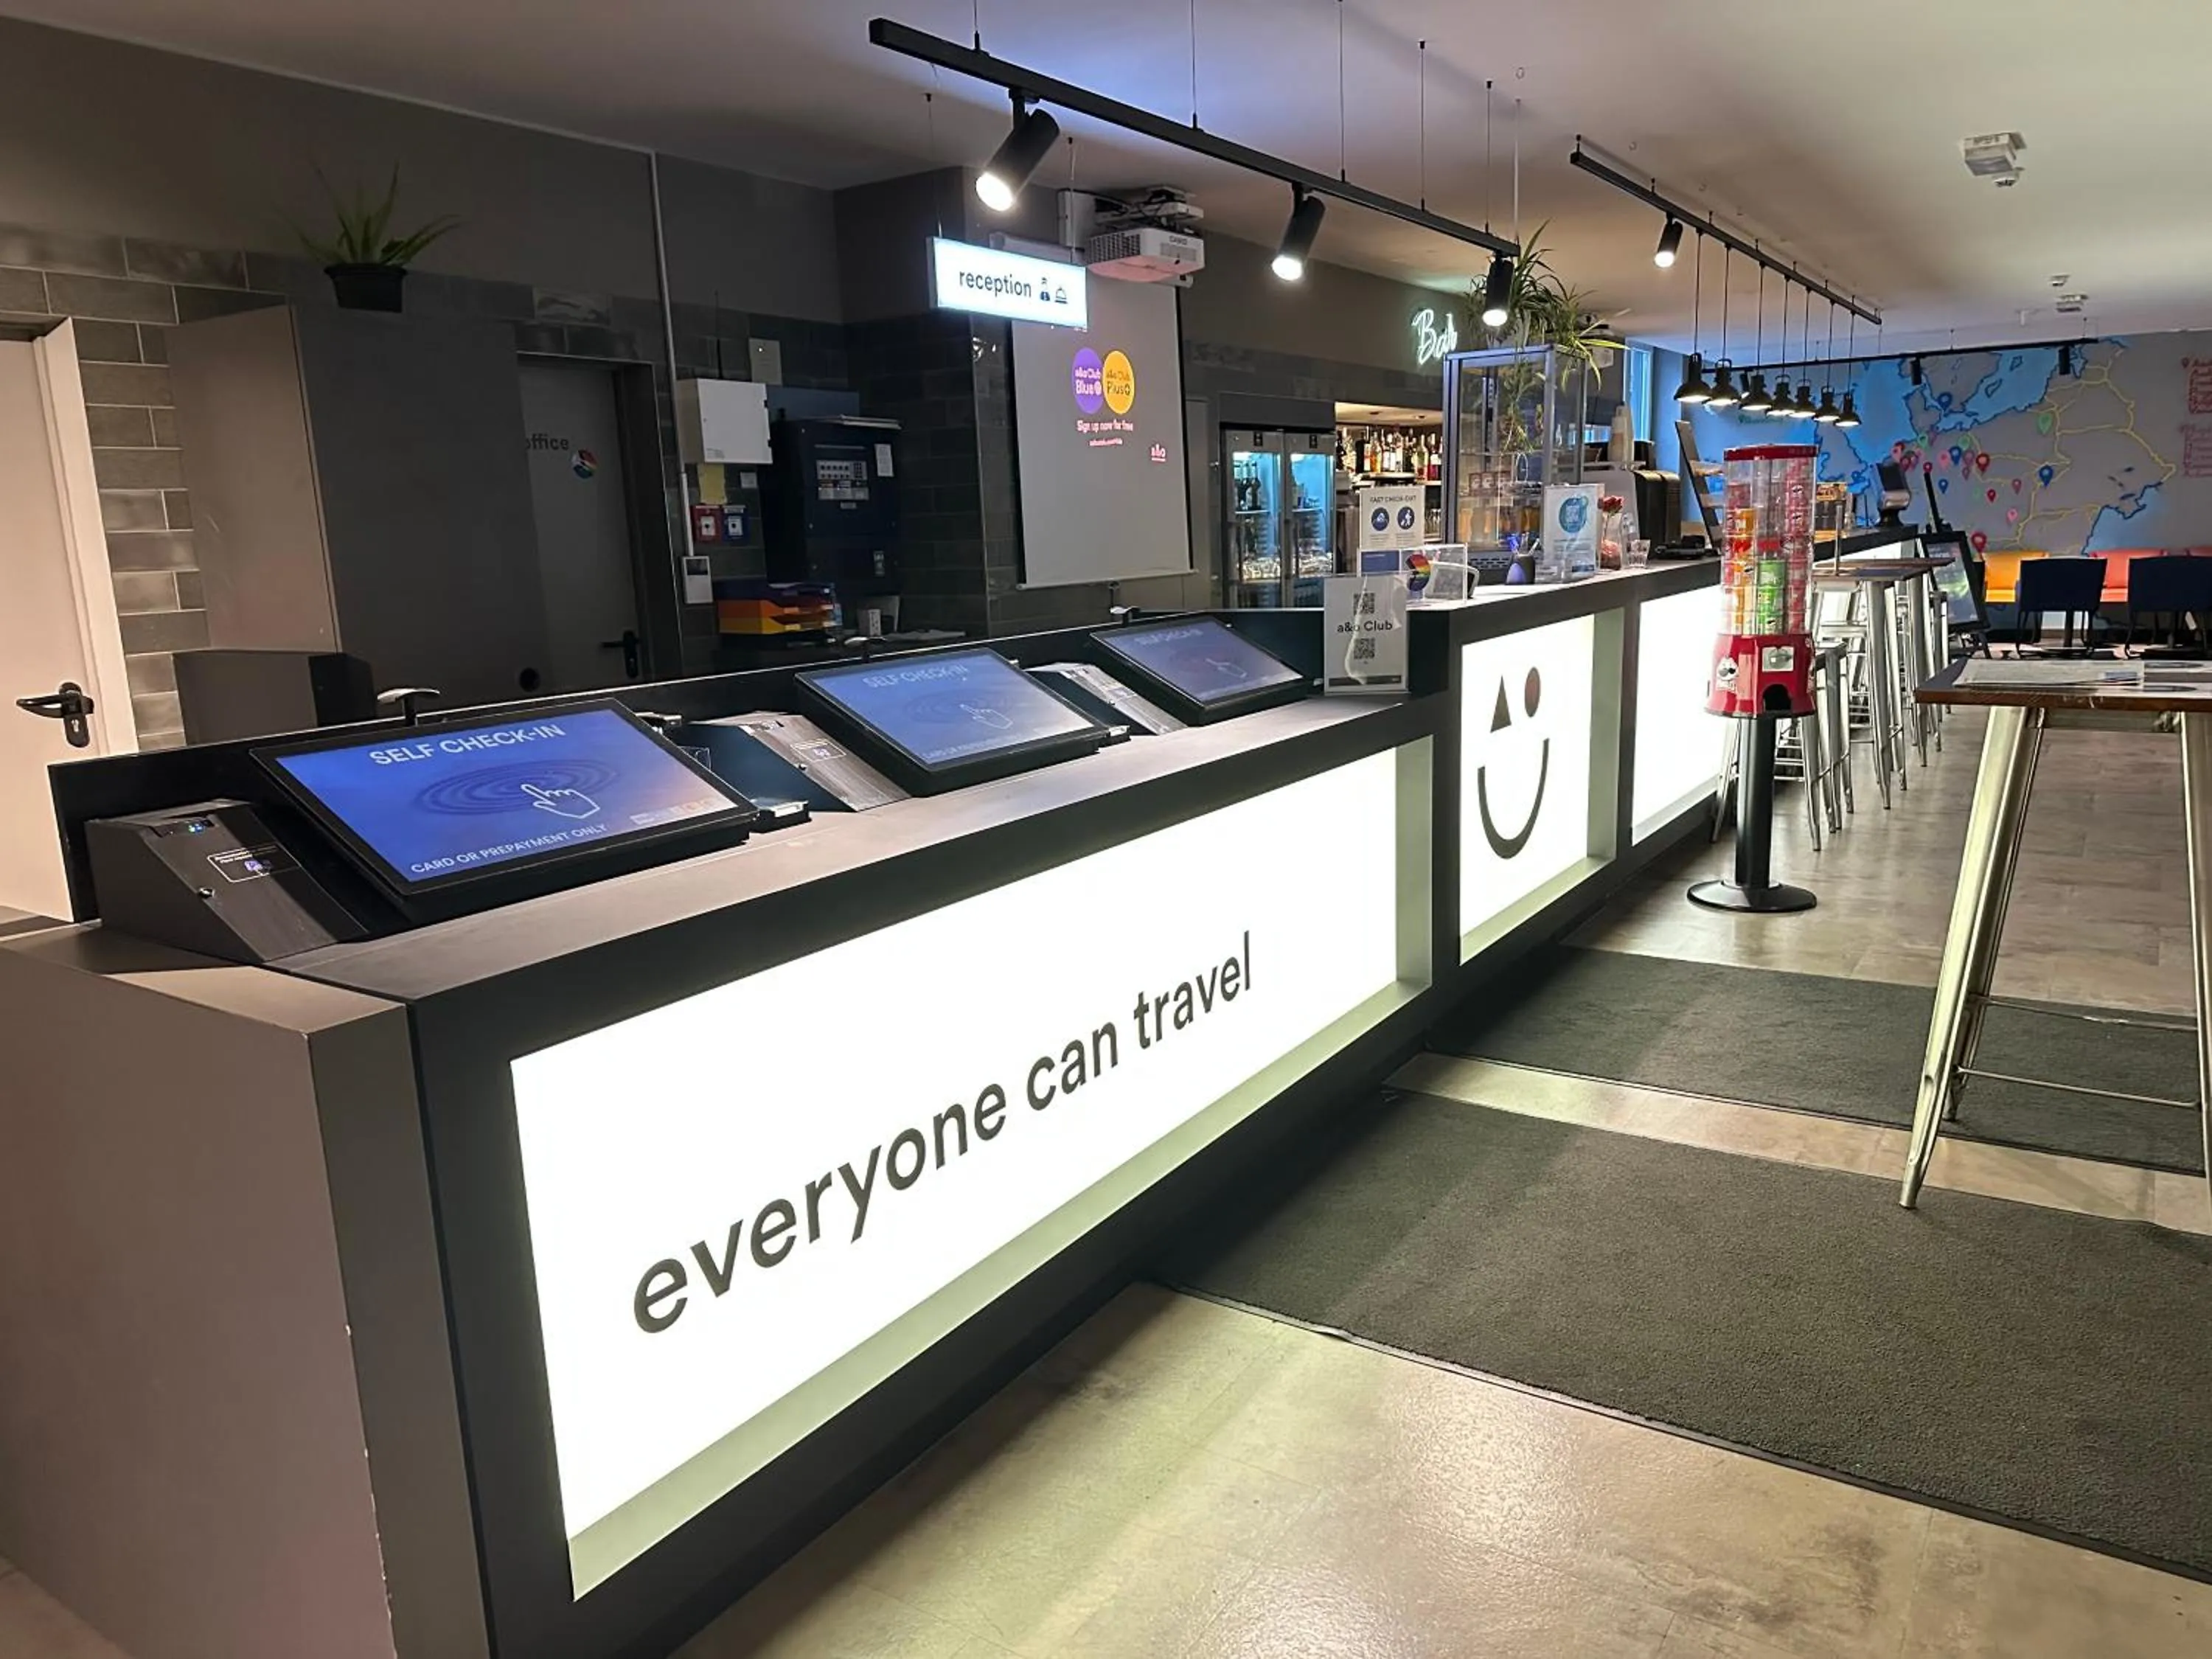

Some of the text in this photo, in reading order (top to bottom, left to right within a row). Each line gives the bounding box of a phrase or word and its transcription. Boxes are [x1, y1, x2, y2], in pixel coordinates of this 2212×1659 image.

[959, 271, 1032, 297] reception
[1411, 308, 1458, 365] Bar
[1076, 380, 1093, 394] Blue
[1107, 381, 1124, 394] Plus
[1077, 420, 1090, 433] Sign
[1364, 620, 1393, 631] Club
[369, 723, 566, 765] SELF CHECK-IN
[411, 824, 608, 873] CARD OR PREPAYMENT ONLY
[634, 930, 1253, 1334] everyone can travel
